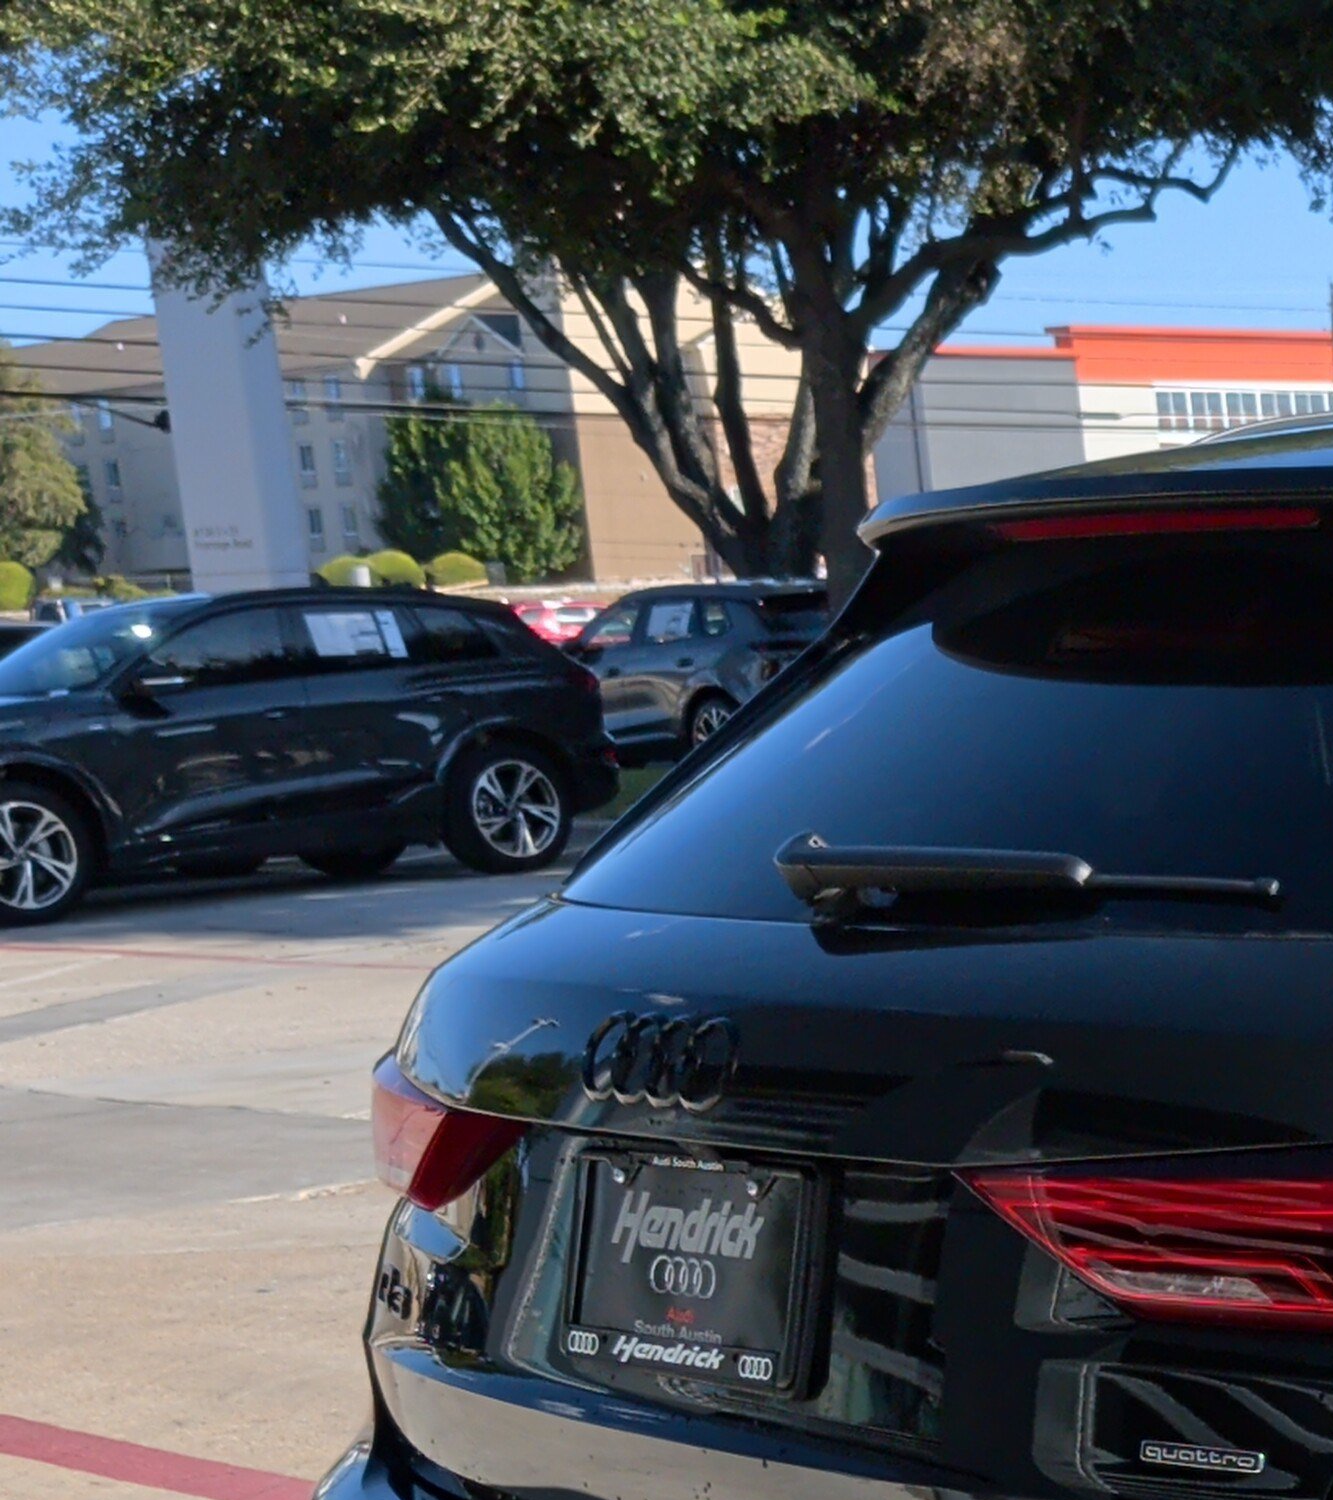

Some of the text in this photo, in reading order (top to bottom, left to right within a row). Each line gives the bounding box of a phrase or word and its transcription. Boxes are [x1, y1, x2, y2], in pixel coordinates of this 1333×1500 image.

[672, 1156, 697, 1169] South
[698, 1160, 724, 1172] Austin
[611, 1190, 765, 1263] Hendrick
[634, 1319, 722, 1345] South Austin
[612, 1335, 725, 1370] Hendrick
[1145, 1446, 1255, 1468] quattro
